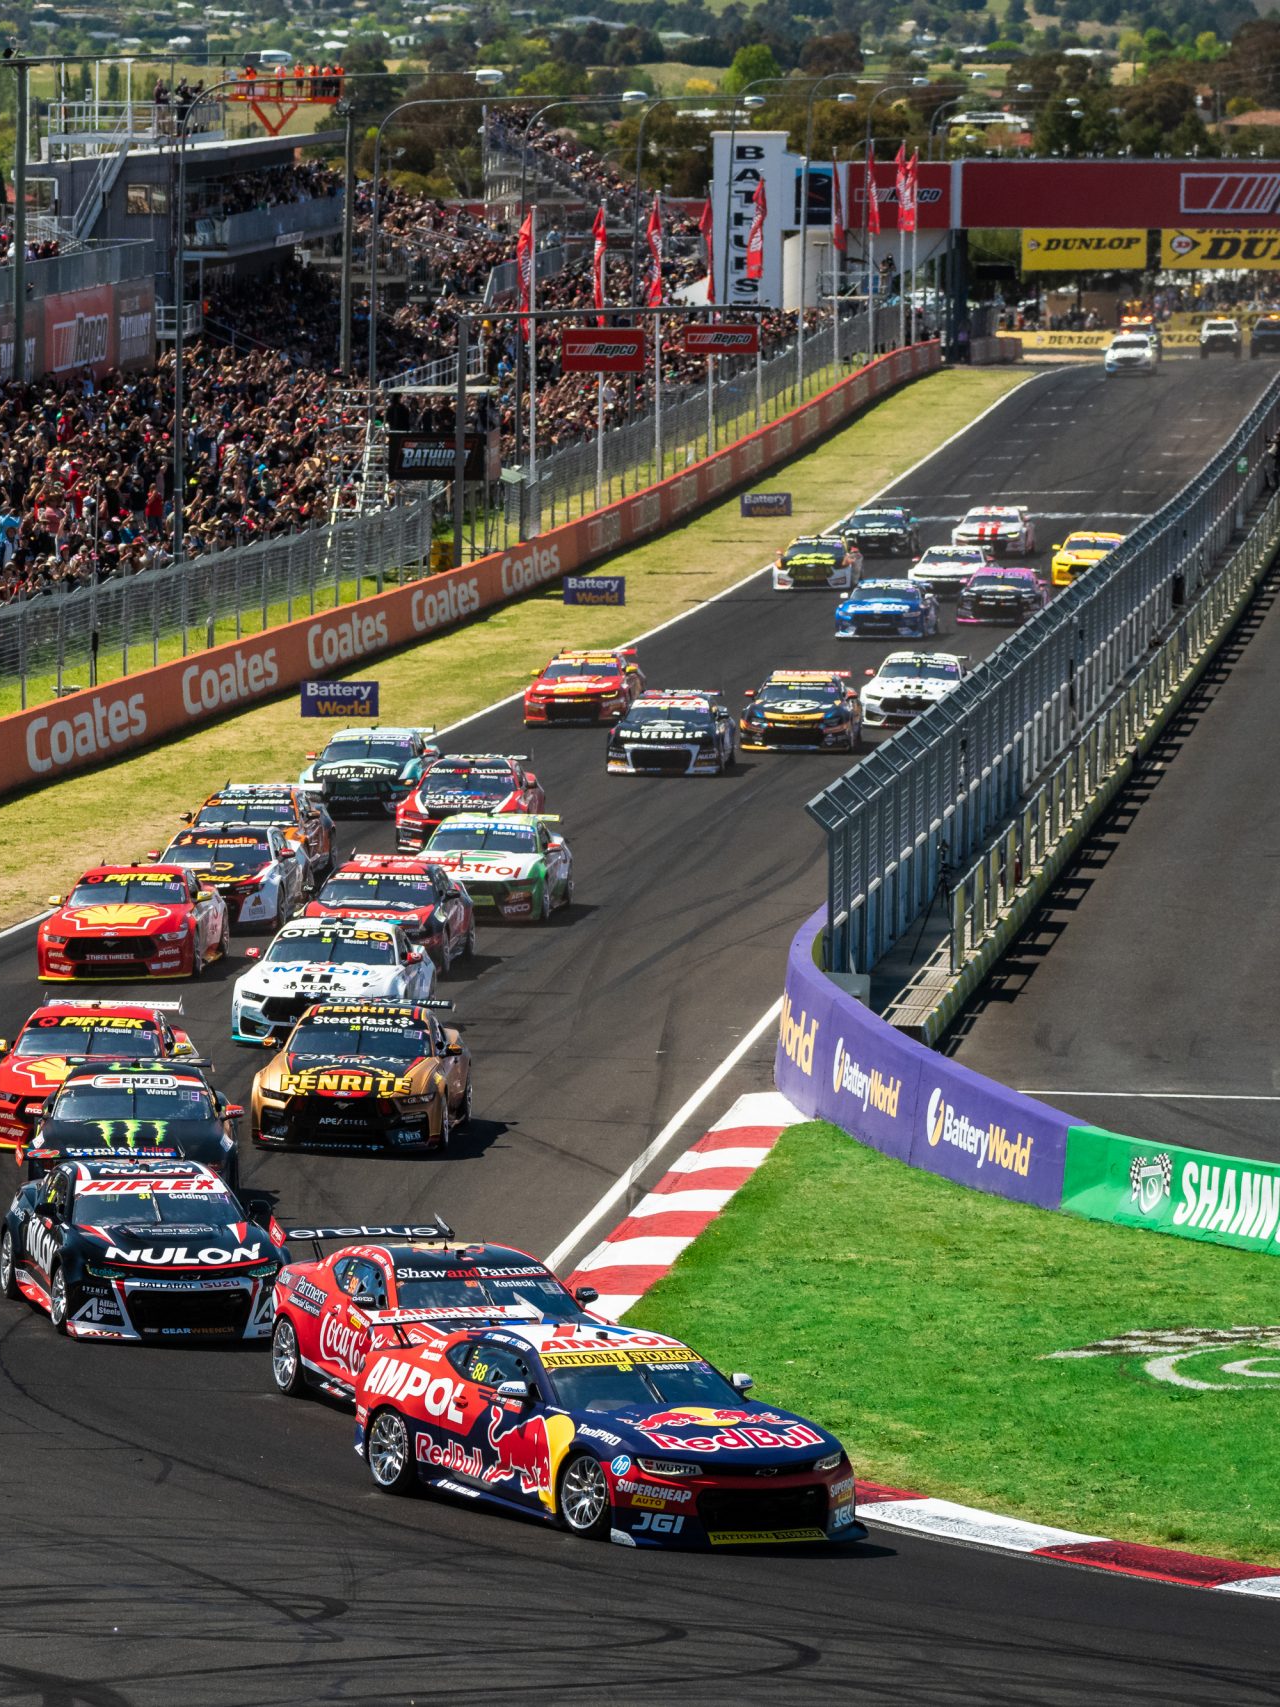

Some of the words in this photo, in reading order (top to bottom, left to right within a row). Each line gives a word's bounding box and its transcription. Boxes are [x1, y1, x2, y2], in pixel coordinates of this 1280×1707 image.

[733, 145, 766, 305] BATHUS
[1044, 237, 1141, 251] DUNLOP
[711, 332, 752, 345] Repco
[1047, 335, 1105, 346] DUNLOP
[594, 343, 638, 358] Repco
[402, 447, 471, 469] BATHURT
[744, 494, 787, 504] Battery
[751, 504, 787, 515] World
[500, 543, 561, 596] Coates
[568, 576, 619, 592] Battery
[576, 591, 619, 604] World
[411, 577, 480, 632] Coates
[307, 611, 388, 670] Coates
[182, 647, 279, 715] Coates
[306, 682, 372, 700] Battery
[316, 700, 371, 715] World
[25, 693, 148, 773] Coates
[620, 730, 703, 740] MOVEMBER
[317, 767, 356, 778] SNOWY
[364, 767, 398, 776] RIVER
[497, 824, 534, 832] STEEL
[196, 836, 258, 845] Scandia
[372, 854, 460, 863] KENWORTH
[104, 873, 175, 883] PIRTEK
[363, 874, 431, 882] BATTERIES
[504, 903, 531, 914] RYCO
[347, 911, 419, 920] TOYOTA
[273, 966, 370, 976] Mobil
[301, 984, 347, 992] YEARS
[317, 1006, 413, 1016] PENRITE
[60, 1016, 146, 1029] PIRTEK
[312, 1016, 394, 1026] Steadfast
[362, 1025, 403, 1034] Reynolds
[331, 1057, 371, 1065] HIRE
[122, 1076, 169, 1086] ENZED
[280, 1073, 413, 1096] PENRITE
[146, 1088, 177, 1096] Waters
[66, 1146, 140, 1155] PremiAir
[143, 1146, 175, 1154] Hire
[81, 1180, 215, 1192] HIFLEX
[169, 1193, 208, 1201] Golding
[289, 1226, 439, 1239] erebus
[26, 1215, 58, 1275] NULON
[105, 1242, 261, 1265] NULON
[139, 1281, 196, 1289] BALLARAT
[200, 1280, 241, 1289] ISUZU
[295, 1275, 328, 1305] Partners
[494, 1279, 537, 1289] Kostecki
[99, 1299, 118, 1308] Atlas
[99, 1306, 121, 1316] Steels
[399, 1306, 507, 1317] AMPLIFY
[161, 1326, 235, 1335] GEARWRENCH
[320, 1311, 367, 1377] Coca-Co
[540, 1335, 688, 1352] AMPOL
[543, 1350, 627, 1367] NATIONAL
[630, 1349, 697, 1363] STORAGE
[472, 1363, 489, 1382] 88
[617, 1363, 633, 1372] 88
[647, 1362, 690, 1372] Feeney
[363, 1356, 466, 1425] AMPOL
[500, 1385, 527, 1394] ACDelco
[577, 1423, 622, 1447] ToolPRO
[641, 1427, 751, 1452] Red
[744, 1424, 826, 1448] Bull
[415, 1432, 455, 1469] Red
[450, 1443, 483, 1479] Bull
[612, 1456, 630, 1476] hp
[655, 1460, 697, 1476] WÜRTH
[615, 1478, 693, 1504] SUPERCHEAP
[635, 1498, 663, 1506] AUTO
[632, 1512, 685, 1534] JGI
[713, 1533, 772, 1542] NATIONAL
[773, 1530, 821, 1540] STORAGE
